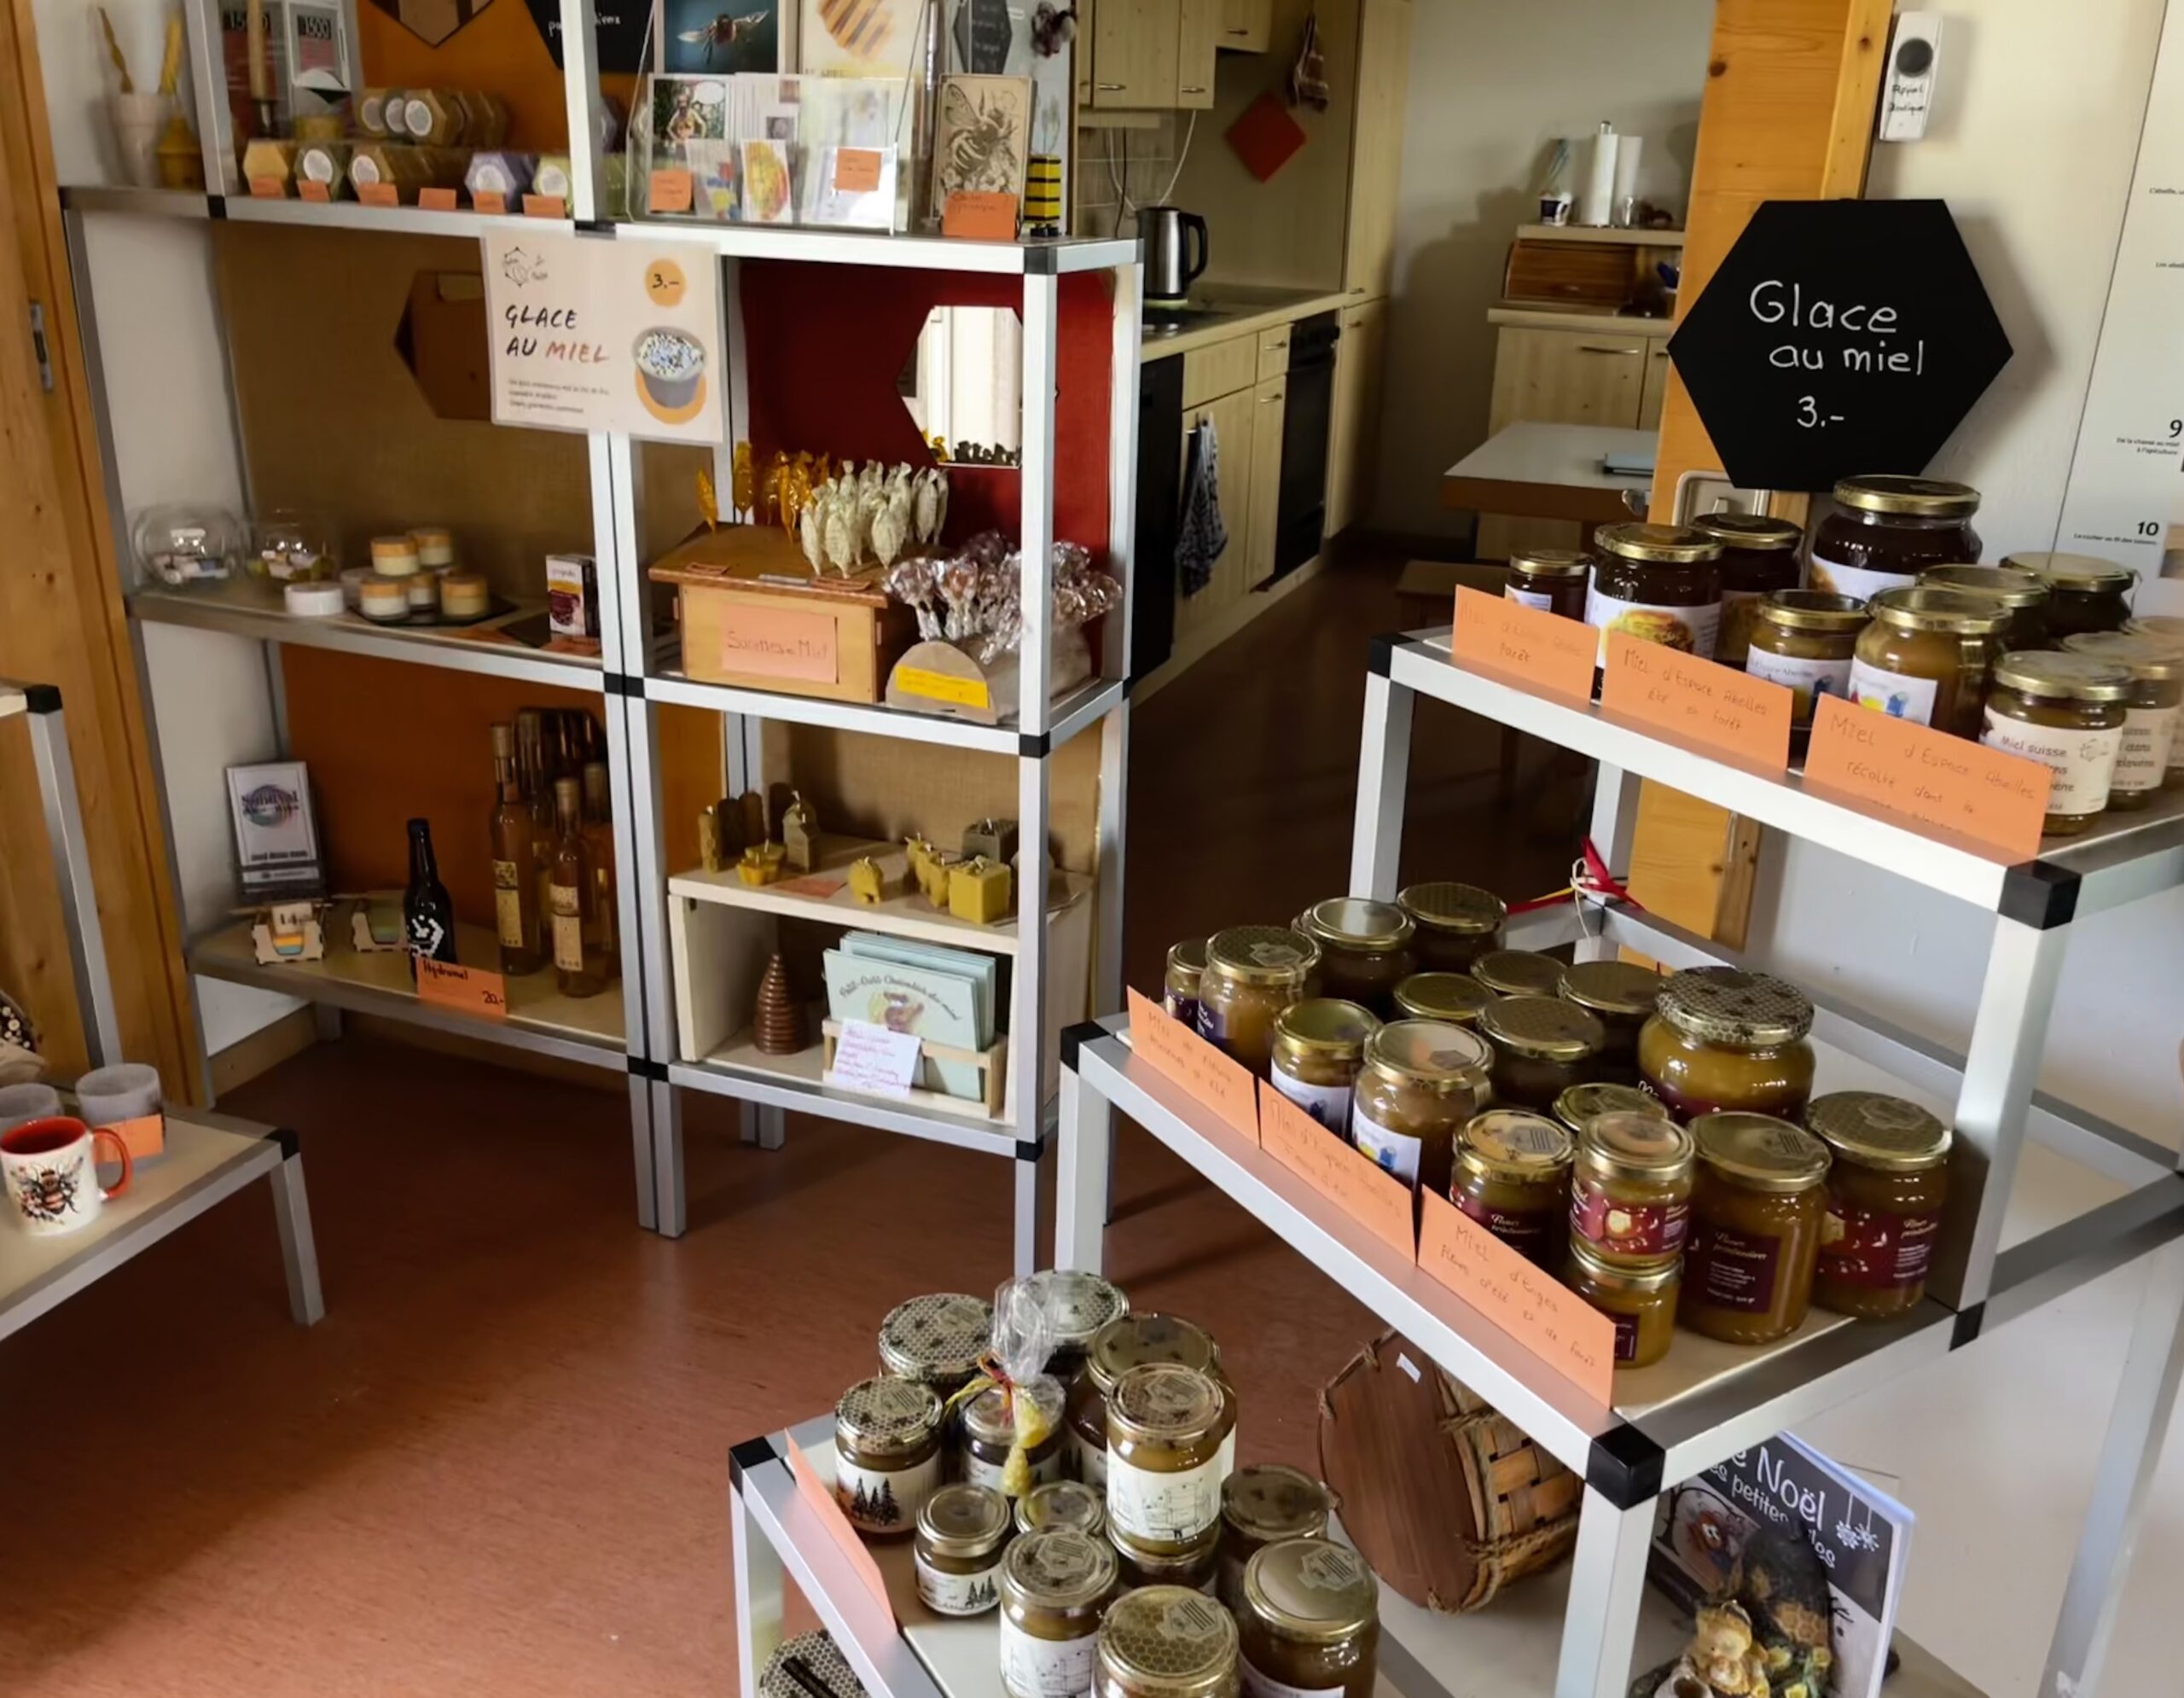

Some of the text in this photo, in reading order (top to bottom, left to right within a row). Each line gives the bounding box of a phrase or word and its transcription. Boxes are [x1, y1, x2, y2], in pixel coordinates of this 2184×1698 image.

[652, 274, 680, 288] 3.-
[505, 305, 578, 329] GLACE
[1750, 280, 1897, 333] Glace
[506, 337, 610, 363] AU MIEL
[1769, 340, 1923, 375] au miel
[1797, 395, 1844, 427] 3.-
[2169, 419, 2182, 439] 9
[2137, 520, 2159, 537] 10
[2001, 736, 2069, 759] Miel suisse
[1756, 1445, 1826, 1531] Noël
